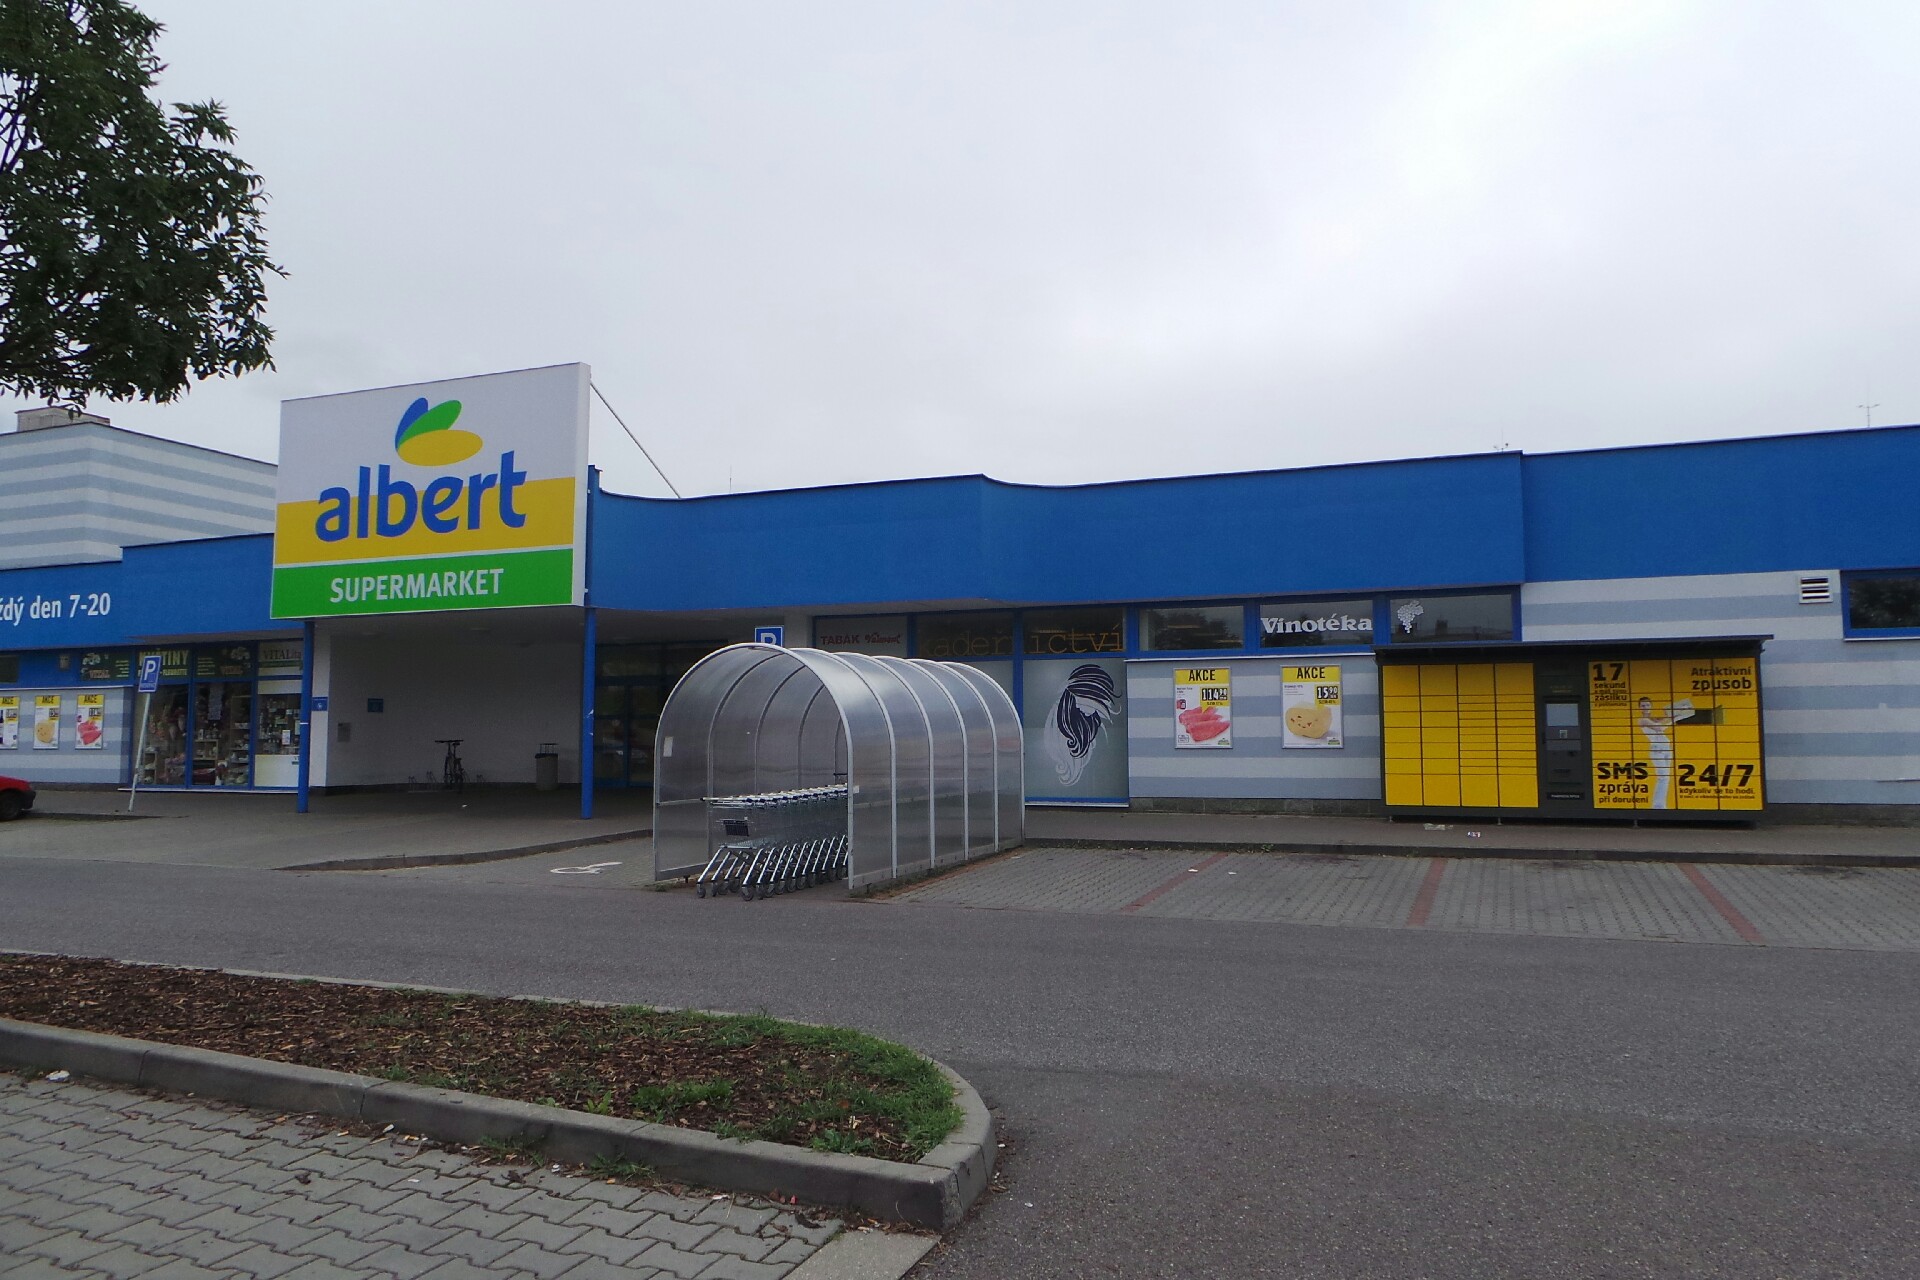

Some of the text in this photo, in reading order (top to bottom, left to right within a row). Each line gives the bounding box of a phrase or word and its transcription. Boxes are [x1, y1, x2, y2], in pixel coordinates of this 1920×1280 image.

[315, 450, 527, 542] albert
[330, 568, 504, 603] SUPERMARKET
[30, 595, 61, 619] den
[69, 592, 111, 618] 7-20
[1261, 613, 1373, 634] Vinotéka
[143, 660, 156, 681] P
[1189, 669, 1216, 681] AKCE
[1297, 667, 1326, 679] AKCE
[1593, 663, 1623, 681] 17
[1597, 762, 1648, 780] SMS
[1678, 764, 1754, 787] 24/7
[1599, 781, 1649, 795] zpráva
